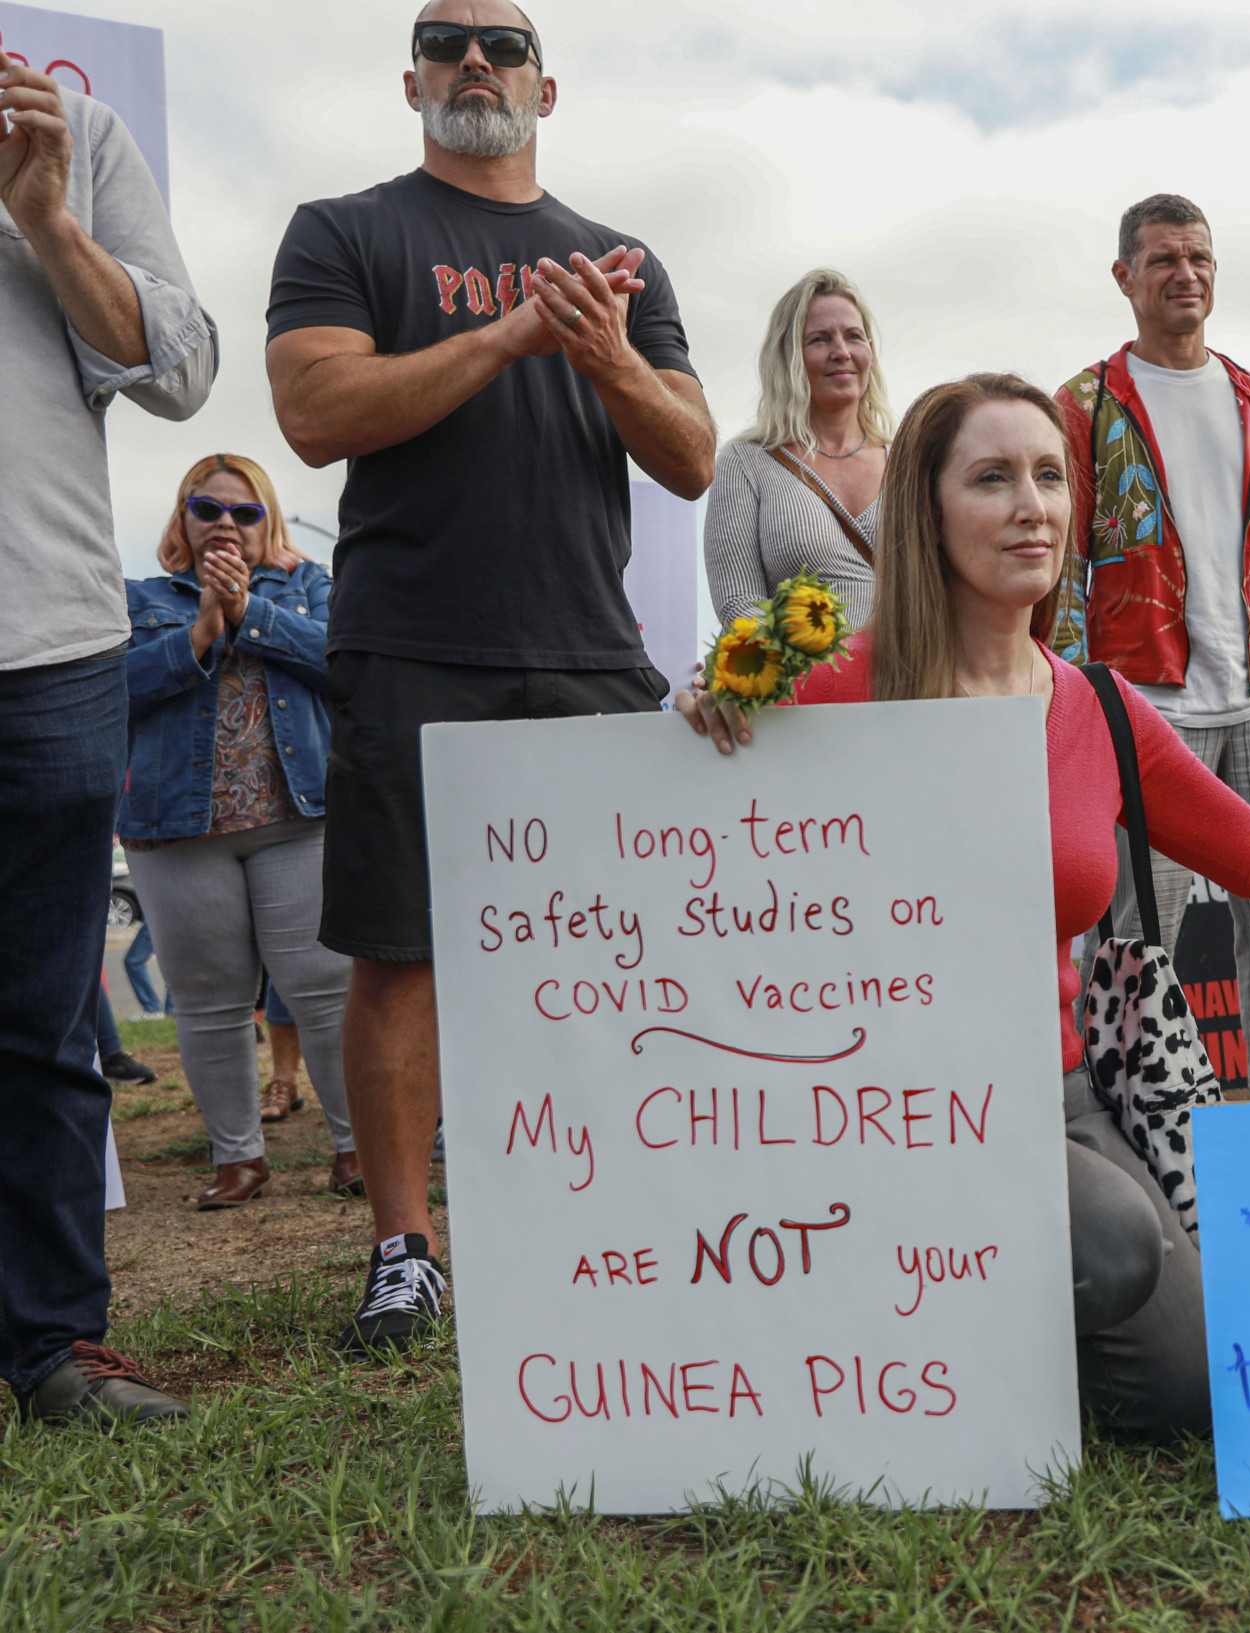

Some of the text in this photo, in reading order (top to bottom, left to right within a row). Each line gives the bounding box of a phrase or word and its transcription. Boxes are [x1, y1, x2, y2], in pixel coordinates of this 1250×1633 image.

[487, 798, 870, 889] NO long-term
[891, 894, 944, 926] on
[534, 978, 689, 1020] COVID
[636, 1084, 993, 1150] CHILDREN
[573, 1203, 998, 1316] ARE NOT your
[518, 1353, 957, 1422] GUINEA PIGS
